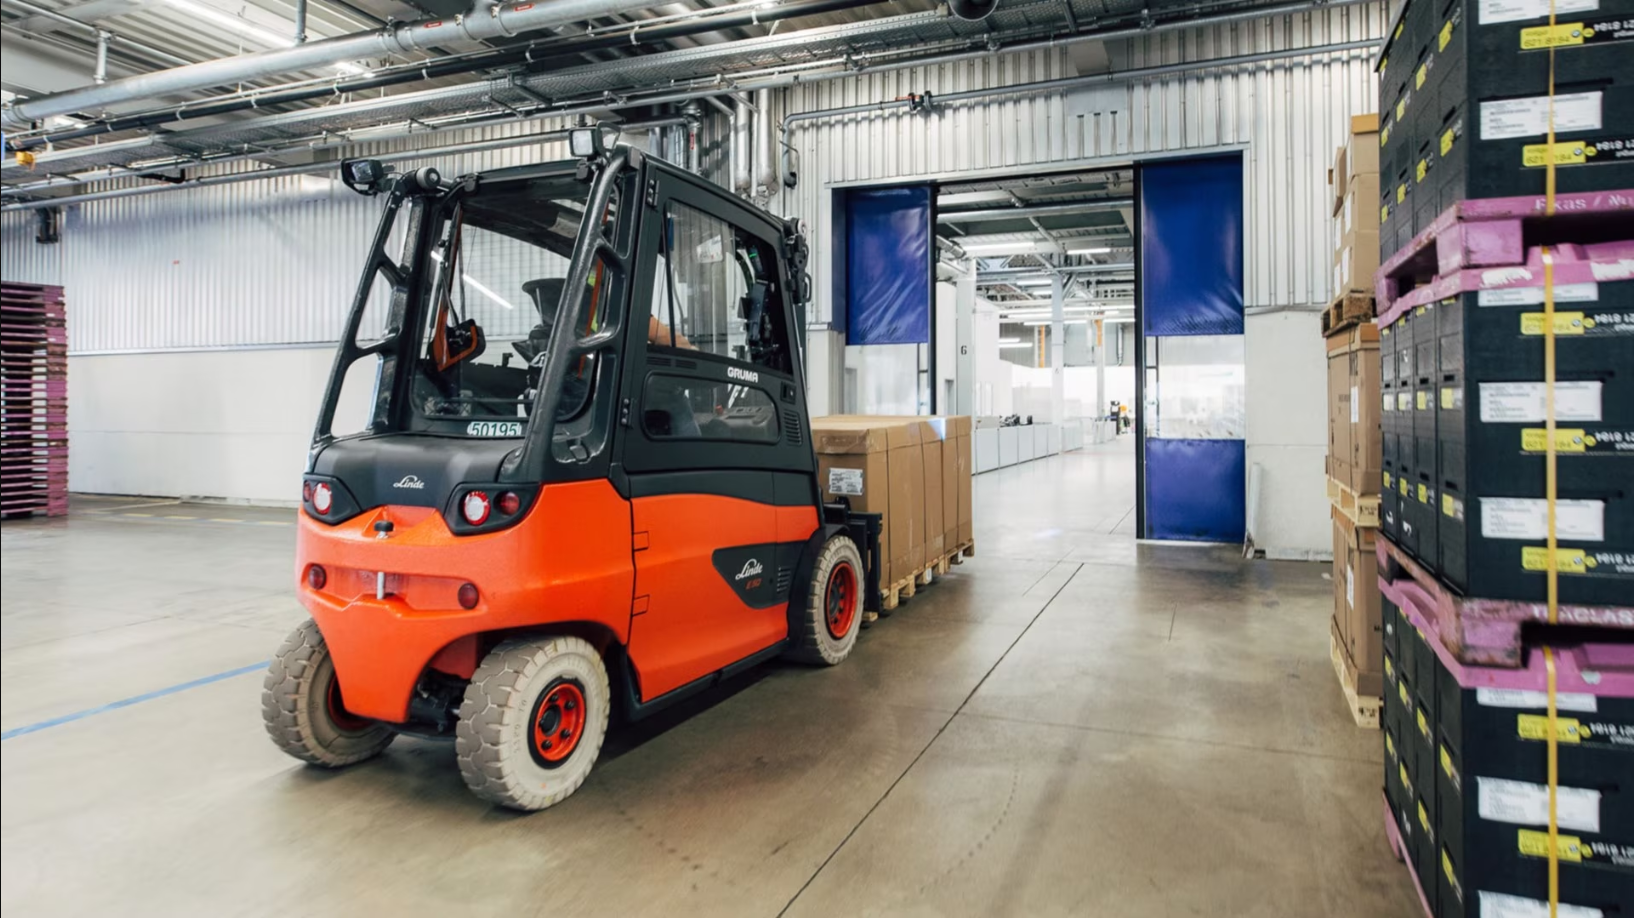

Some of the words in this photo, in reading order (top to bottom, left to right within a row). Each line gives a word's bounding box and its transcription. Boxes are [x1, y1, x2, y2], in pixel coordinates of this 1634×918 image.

[727, 366, 759, 383] GRUMA
[472, 422, 518, 436] 50195
[393, 474, 425, 489] Linde
[735, 558, 763, 580] Linde
